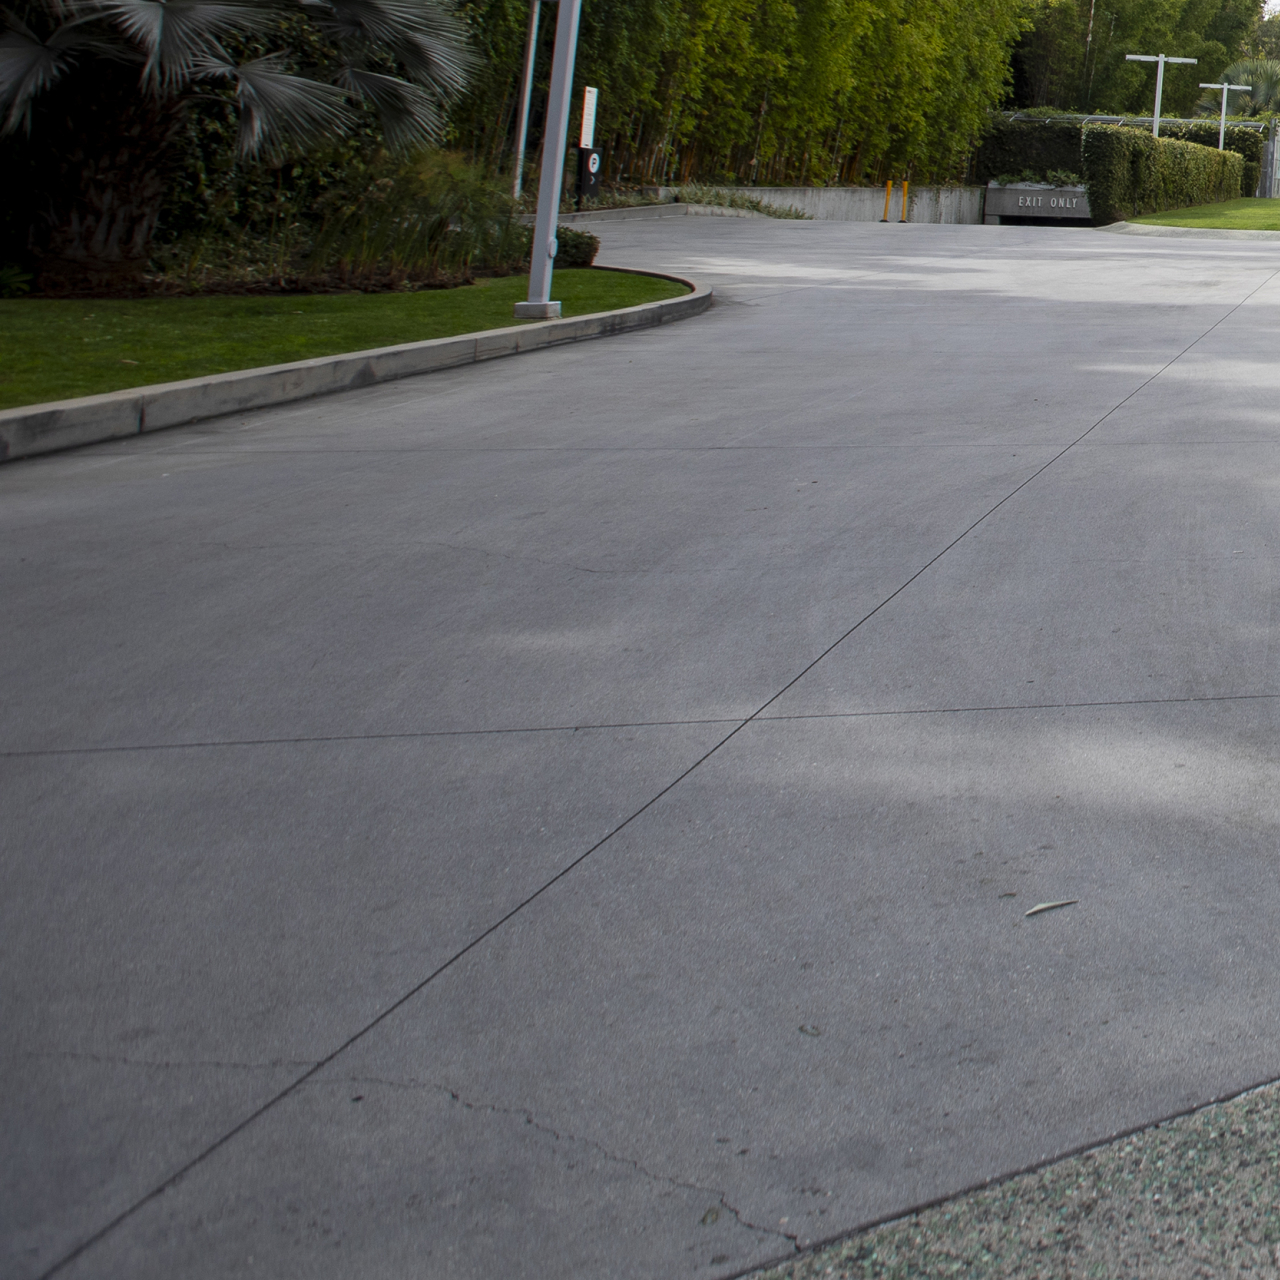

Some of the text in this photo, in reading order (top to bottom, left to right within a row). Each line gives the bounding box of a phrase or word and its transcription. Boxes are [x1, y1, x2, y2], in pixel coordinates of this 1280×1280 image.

[591, 157, 597, 168] P
[1018, 196, 1078, 208] EXIT ONLY
